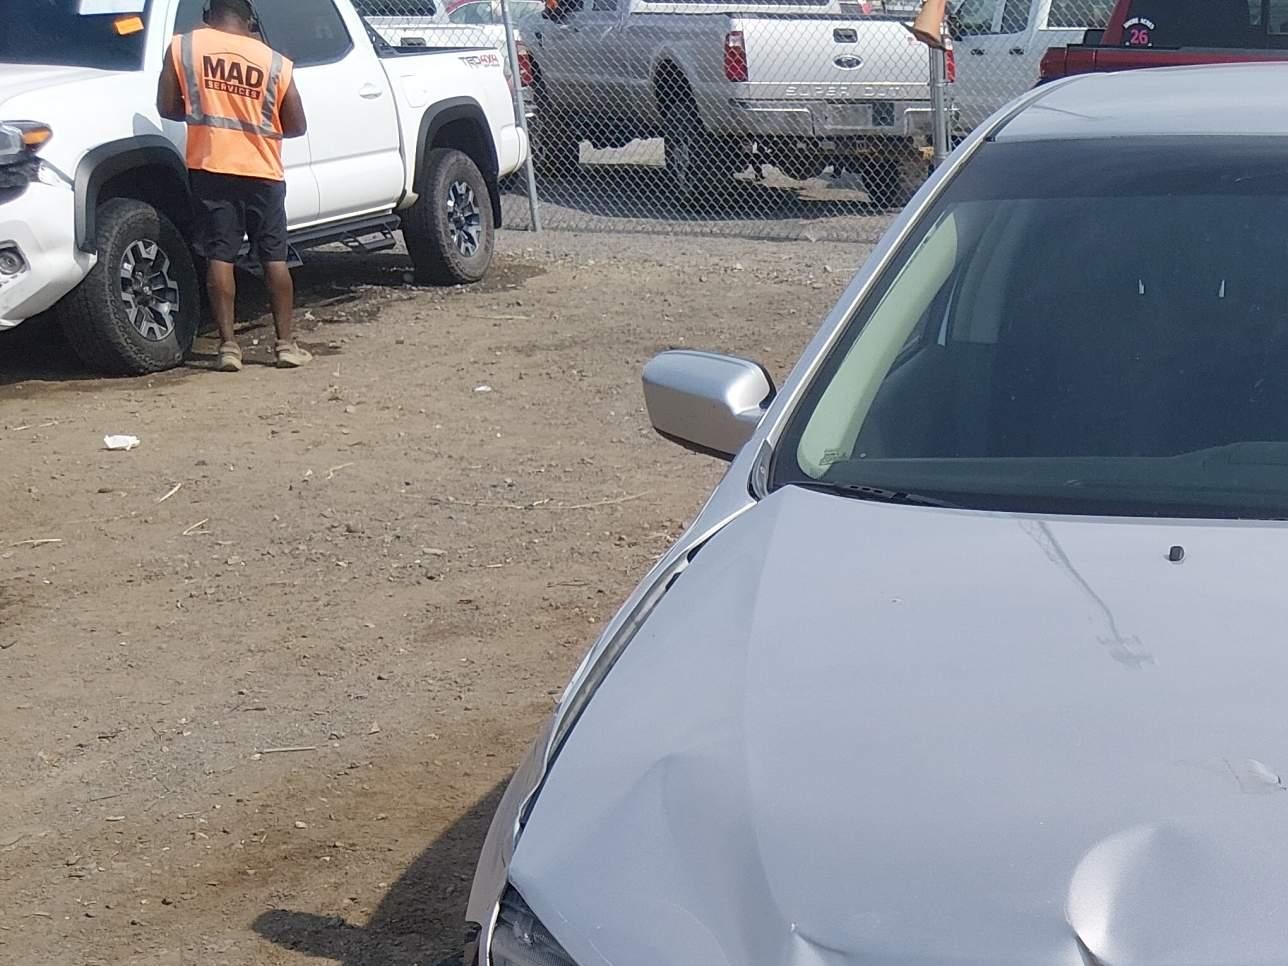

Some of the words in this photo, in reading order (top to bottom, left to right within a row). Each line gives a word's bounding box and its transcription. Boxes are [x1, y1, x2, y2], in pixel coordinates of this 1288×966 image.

[1131, 29, 1149, 44] 26
[203, 55, 264, 88] MAD
[208, 81, 258, 98] SERVICES
